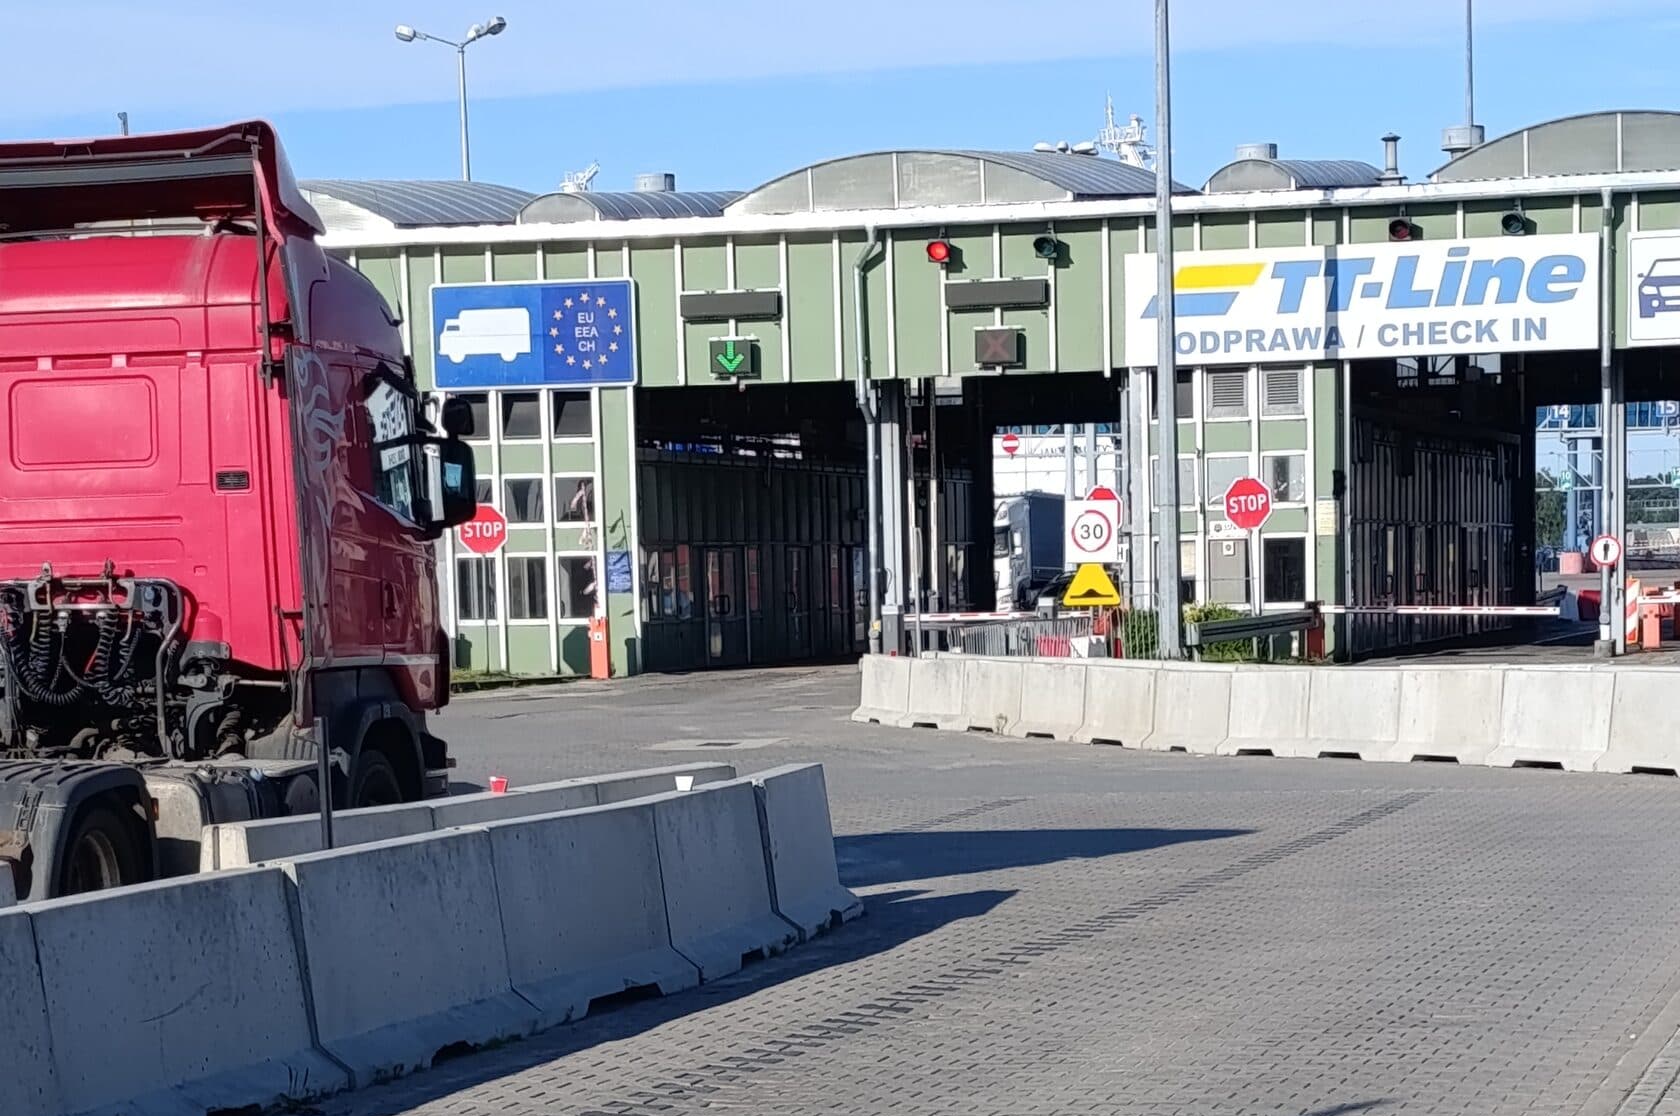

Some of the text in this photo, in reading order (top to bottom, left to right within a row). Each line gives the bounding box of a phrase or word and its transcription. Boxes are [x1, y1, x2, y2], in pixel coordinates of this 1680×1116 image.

[1271, 246, 1587, 314] TT-Line
[577, 311, 595, 324] EU
[574, 326, 600, 338] EEA
[1175, 325, 1346, 355] ODPRAWA
[1377, 319, 1499, 347] CHECK
[1512, 317, 1547, 341] IN
[578, 340, 596, 352] CH
[1228, 493, 1267, 514] STOP
[463, 521, 504, 538] STOP
[1080, 523, 1104, 540] 30
